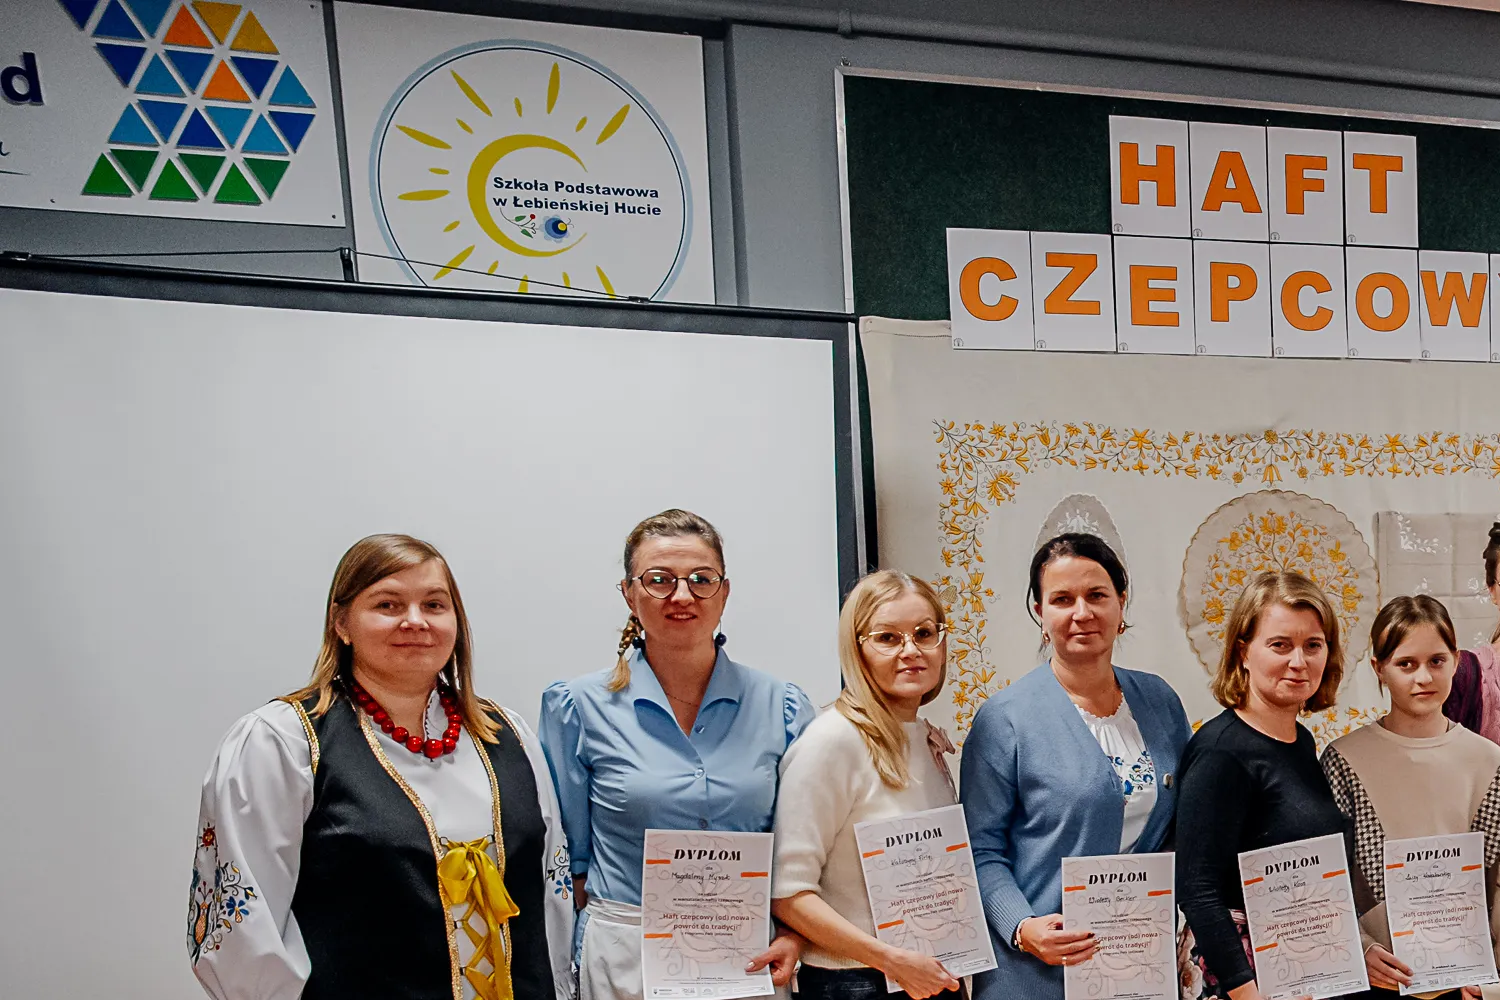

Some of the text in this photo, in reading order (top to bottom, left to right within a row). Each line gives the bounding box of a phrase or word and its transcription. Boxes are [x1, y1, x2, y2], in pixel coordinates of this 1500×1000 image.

[493, 177, 659, 198] Szkoła Podstawowa
[1118, 142, 1403, 215] HAFT
[493, 196, 662, 215] w Łebieńskiej Hucie
[886, 828, 943, 848] DYPLOM
[673, 849, 741, 861] DYPLOM
[1406, 847, 1461, 862] DYPLOM
[1265, 855, 1320, 876] DYPLOM
[1088, 871, 1147, 885] DYPLOM
[680, 913, 714, 922] czepcowy
